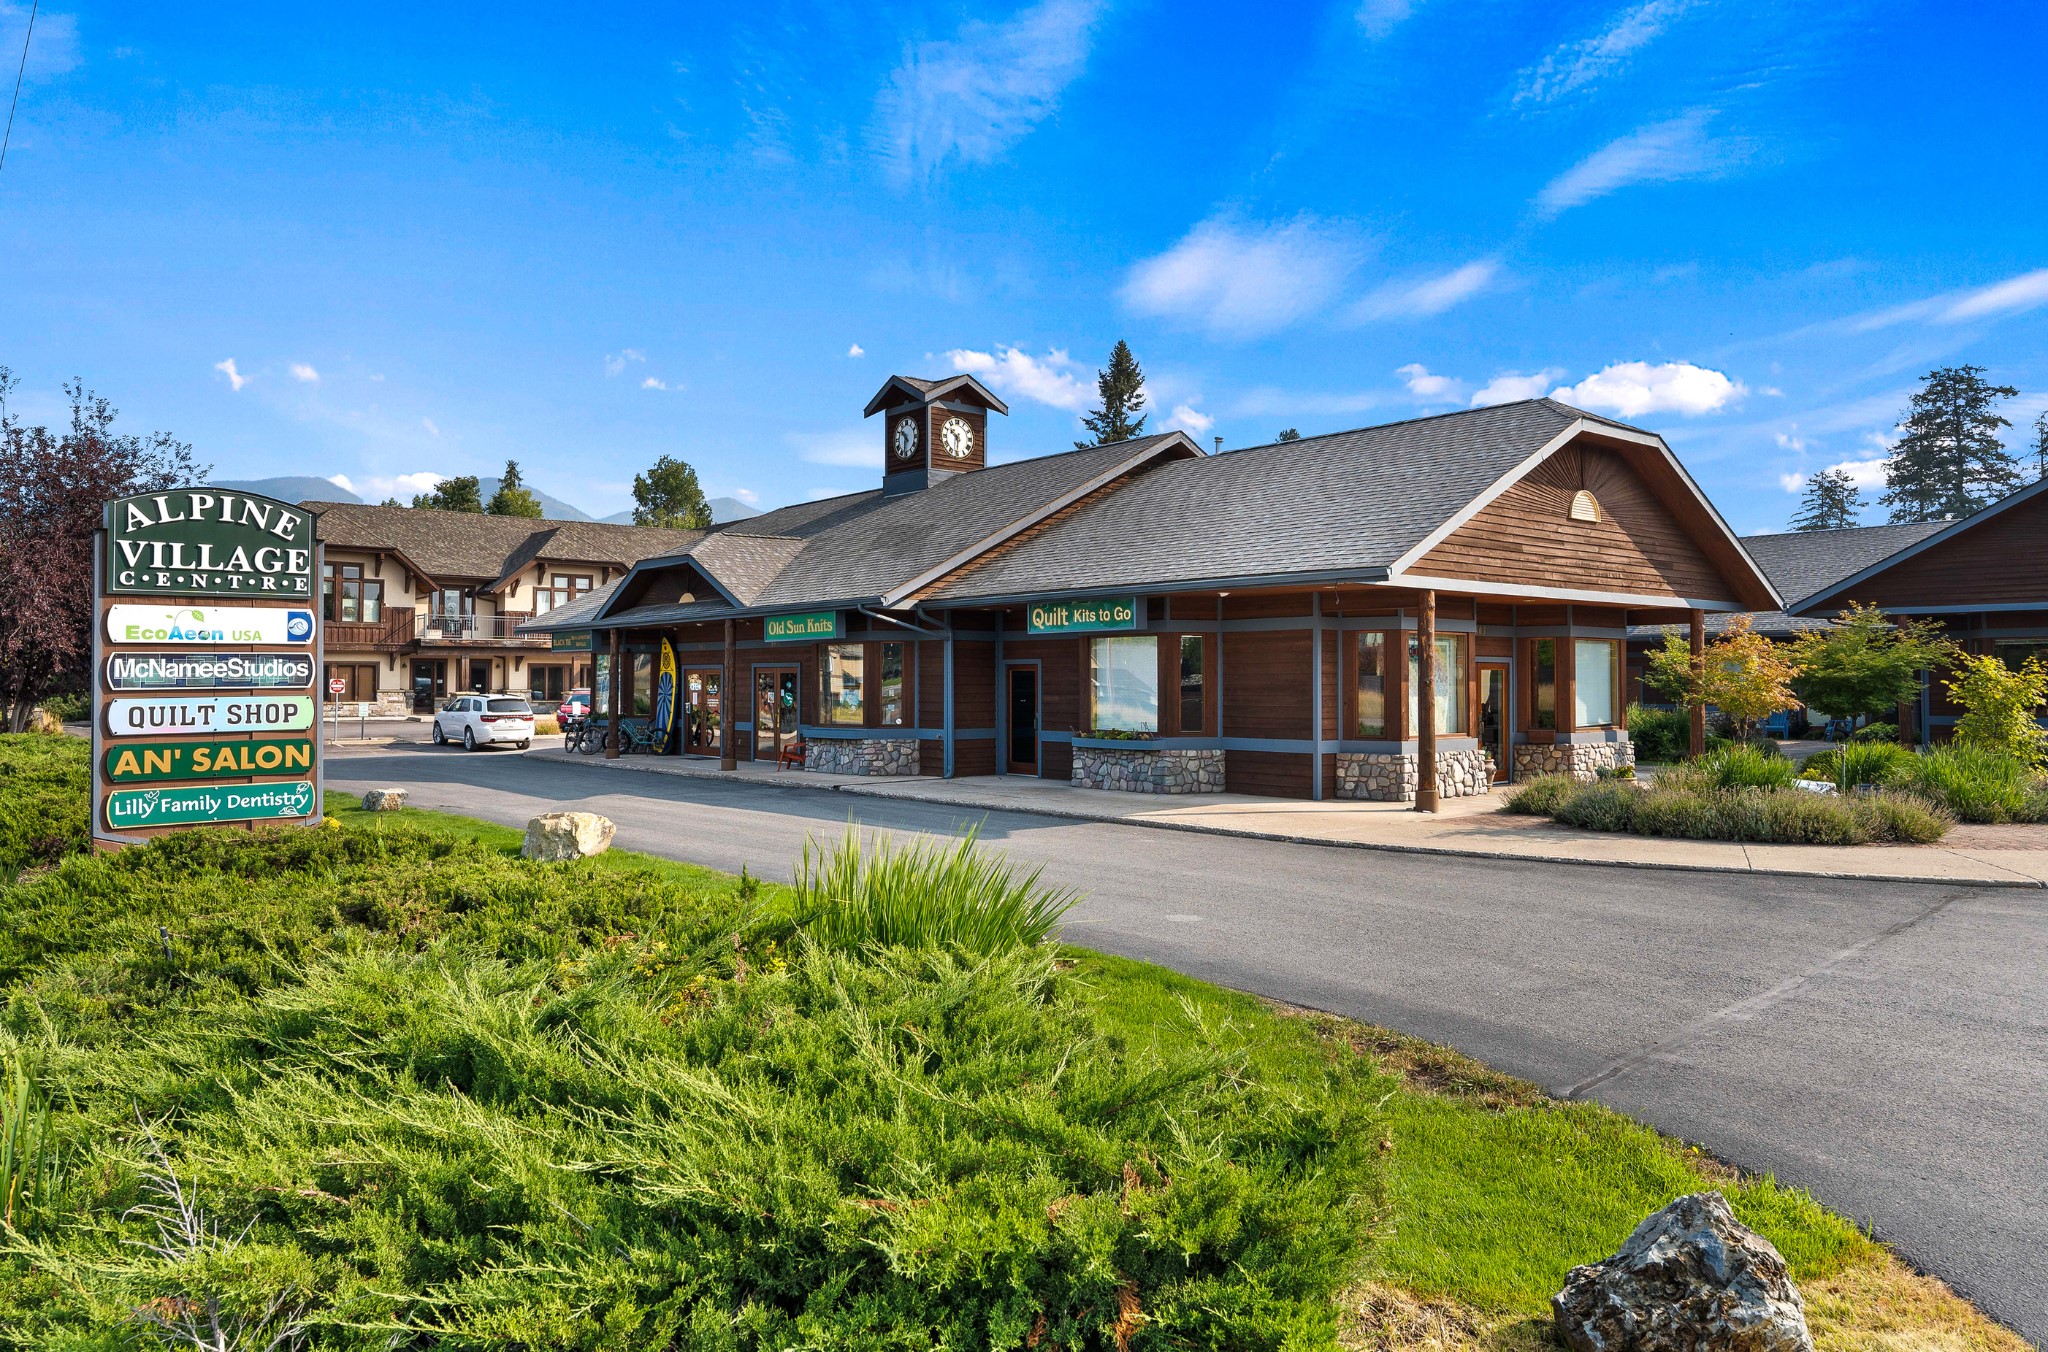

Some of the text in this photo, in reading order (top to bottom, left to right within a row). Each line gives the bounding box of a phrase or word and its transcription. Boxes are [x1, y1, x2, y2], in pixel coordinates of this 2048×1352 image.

[125, 493, 302, 542] ALPINE
[116, 539, 310, 575] VILLAGE
[768, 618, 833, 635] Old Sun Knits
[1032, 606, 1132, 630] Quilt Kits to Go
[125, 625, 263, 641] EcoAeon USA
[114, 657, 309, 678] McNameeStudios
[128, 703, 299, 729] QUILT SHOP
[113, 744, 310, 776] AN' SALON
[114, 791, 309, 819] Lilly Family Dentistry
